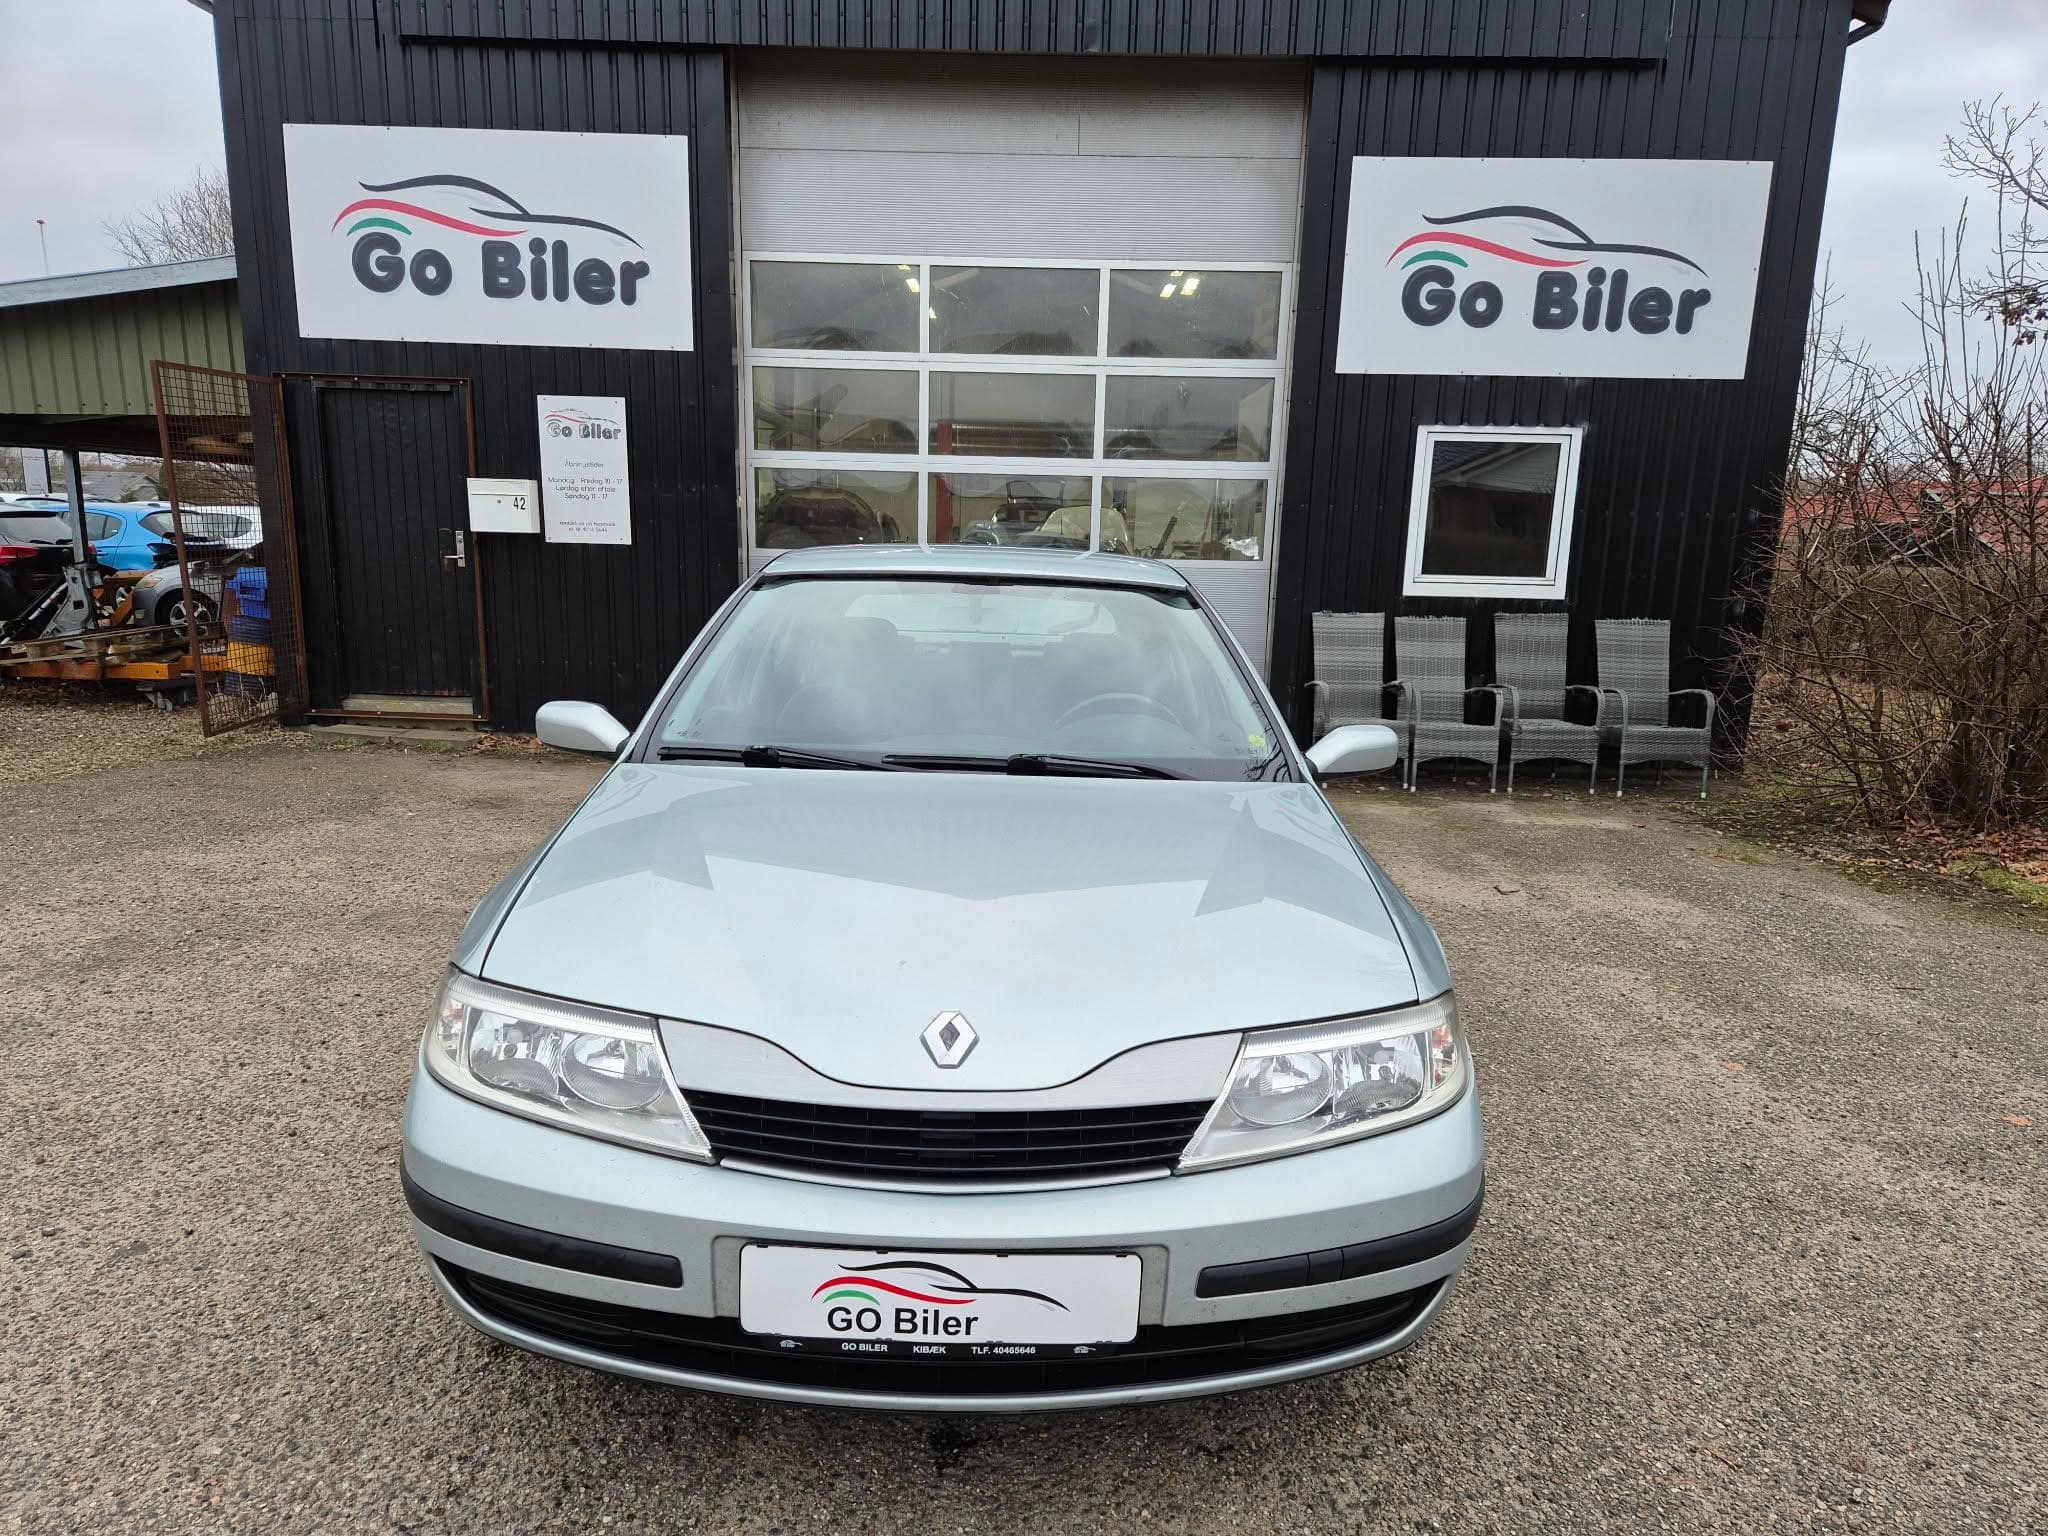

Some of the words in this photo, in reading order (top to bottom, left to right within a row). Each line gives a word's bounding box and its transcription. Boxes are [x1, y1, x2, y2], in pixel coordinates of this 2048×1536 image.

[352, 232, 453, 296] Go
[481, 237, 650, 306] Biler
[1401, 264, 1504, 328] Go
[1532, 266, 1712, 335] Biler
[547, 421, 573, 438] Go
[579, 422, 621, 439] Biler
[548, 476, 575, 485] Mandag
[580, 477, 603, 486] Fredag
[513, 496, 527, 511] 42
[827, 1306, 882, 1333] GO
[894, 1307, 979, 1336] Biler
[841, 1342, 857, 1351] GO
[859, 1343, 888, 1352] BILER
[912, 1345, 947, 1354] KIBÆK
[971, 1346, 991, 1354] TLF.
